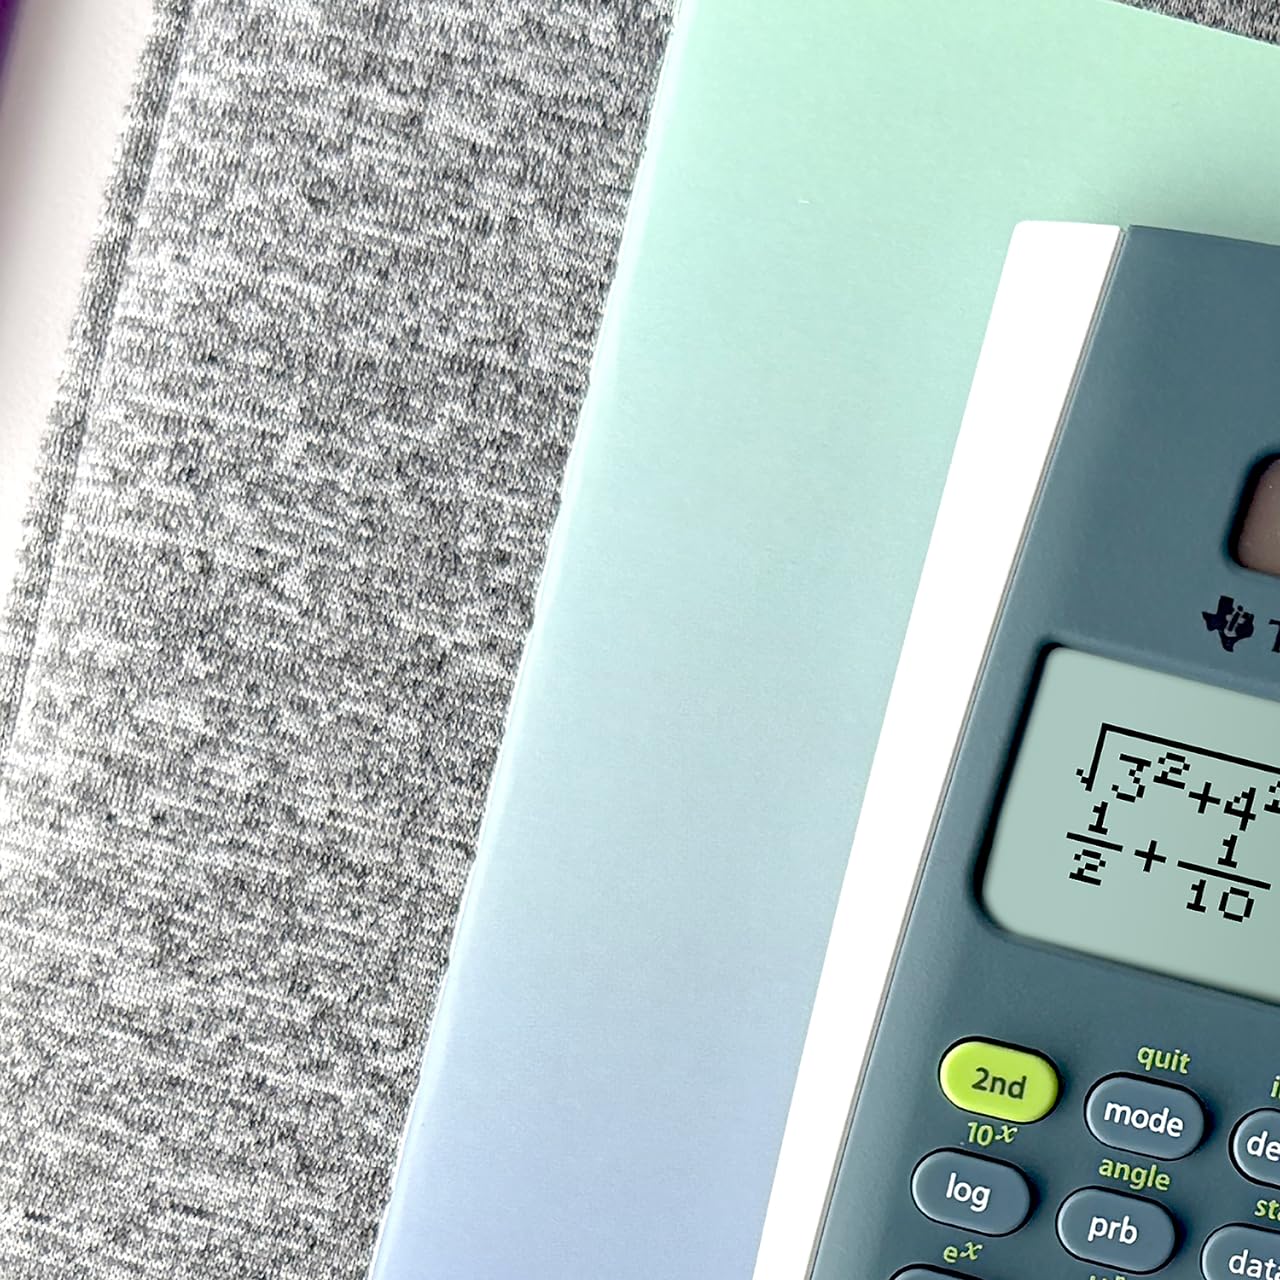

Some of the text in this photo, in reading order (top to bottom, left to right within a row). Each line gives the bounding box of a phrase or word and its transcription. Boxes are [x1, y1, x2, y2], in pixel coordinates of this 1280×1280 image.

[1137, 1045, 1190, 1075] quit
[971, 1066, 1026, 1100] 2nd
[1104, 1100, 1184, 1138] mode
[945, 1173, 991, 1211] log
[1098, 1158, 1171, 1192] angle
[1087, 1214, 1138, 1245] prb
